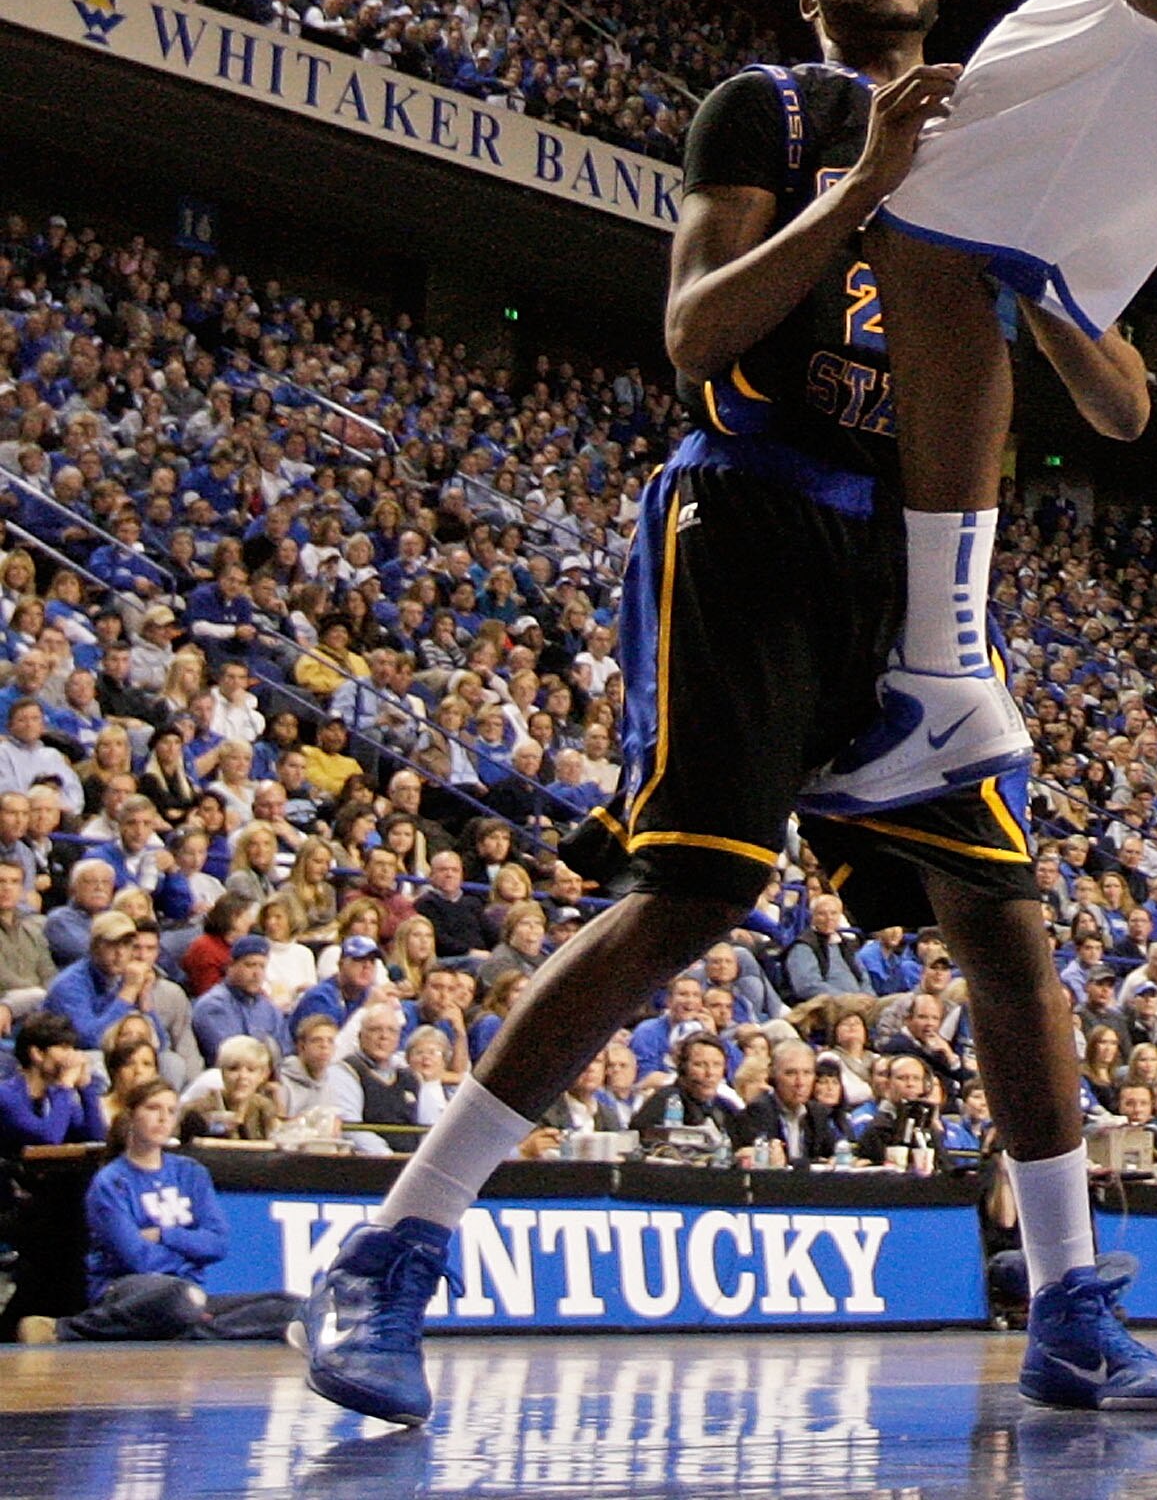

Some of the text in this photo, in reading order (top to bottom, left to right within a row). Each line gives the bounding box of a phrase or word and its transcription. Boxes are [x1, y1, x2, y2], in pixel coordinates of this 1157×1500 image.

[150, 3, 684, 223] WHITAKER BANK
[271, 1199, 892, 1318] KNTUCKY
